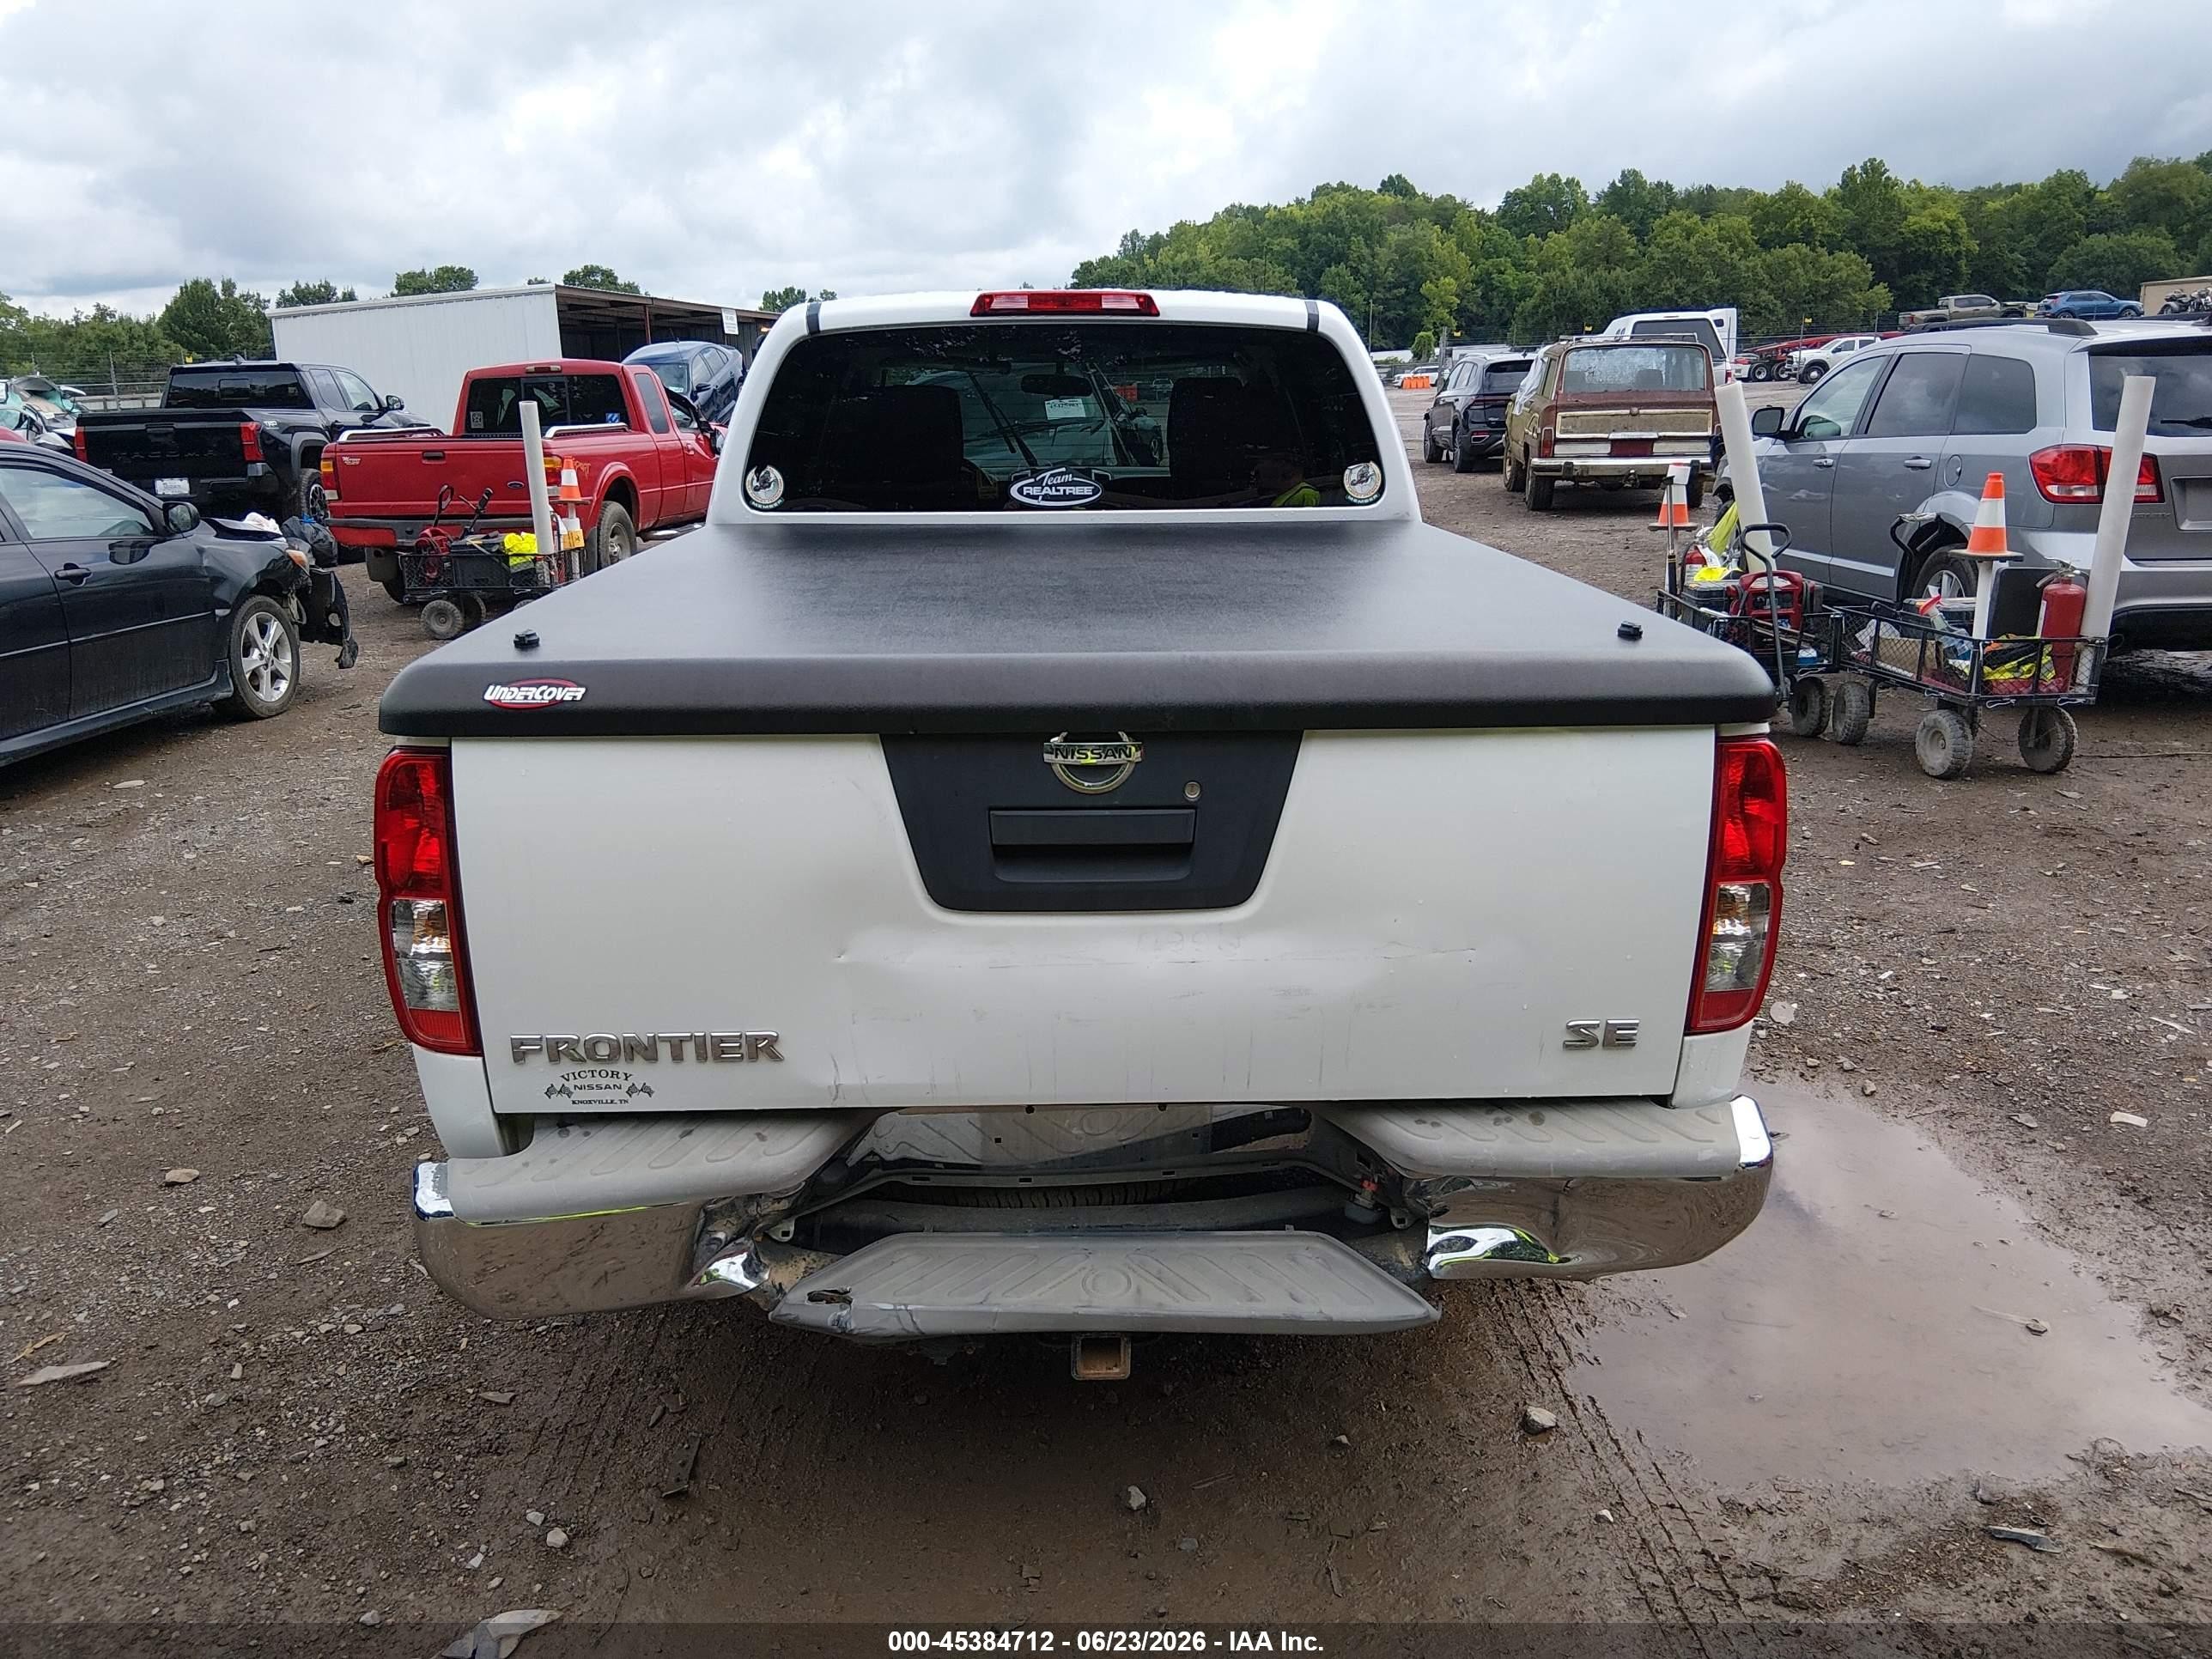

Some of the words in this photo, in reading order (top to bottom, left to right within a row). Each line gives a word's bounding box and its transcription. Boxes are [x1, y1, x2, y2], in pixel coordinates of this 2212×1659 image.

[1036, 467, 1073, 486] Team
[1023, 486, 1095, 495] REALTREE
[1054, 747, 1132, 760] NISSAN
[1563, 1018, 1640, 1051] SE
[510, 1030, 785, 1064] FRONTIER
[560, 1069, 634, 1082] VICTORY
